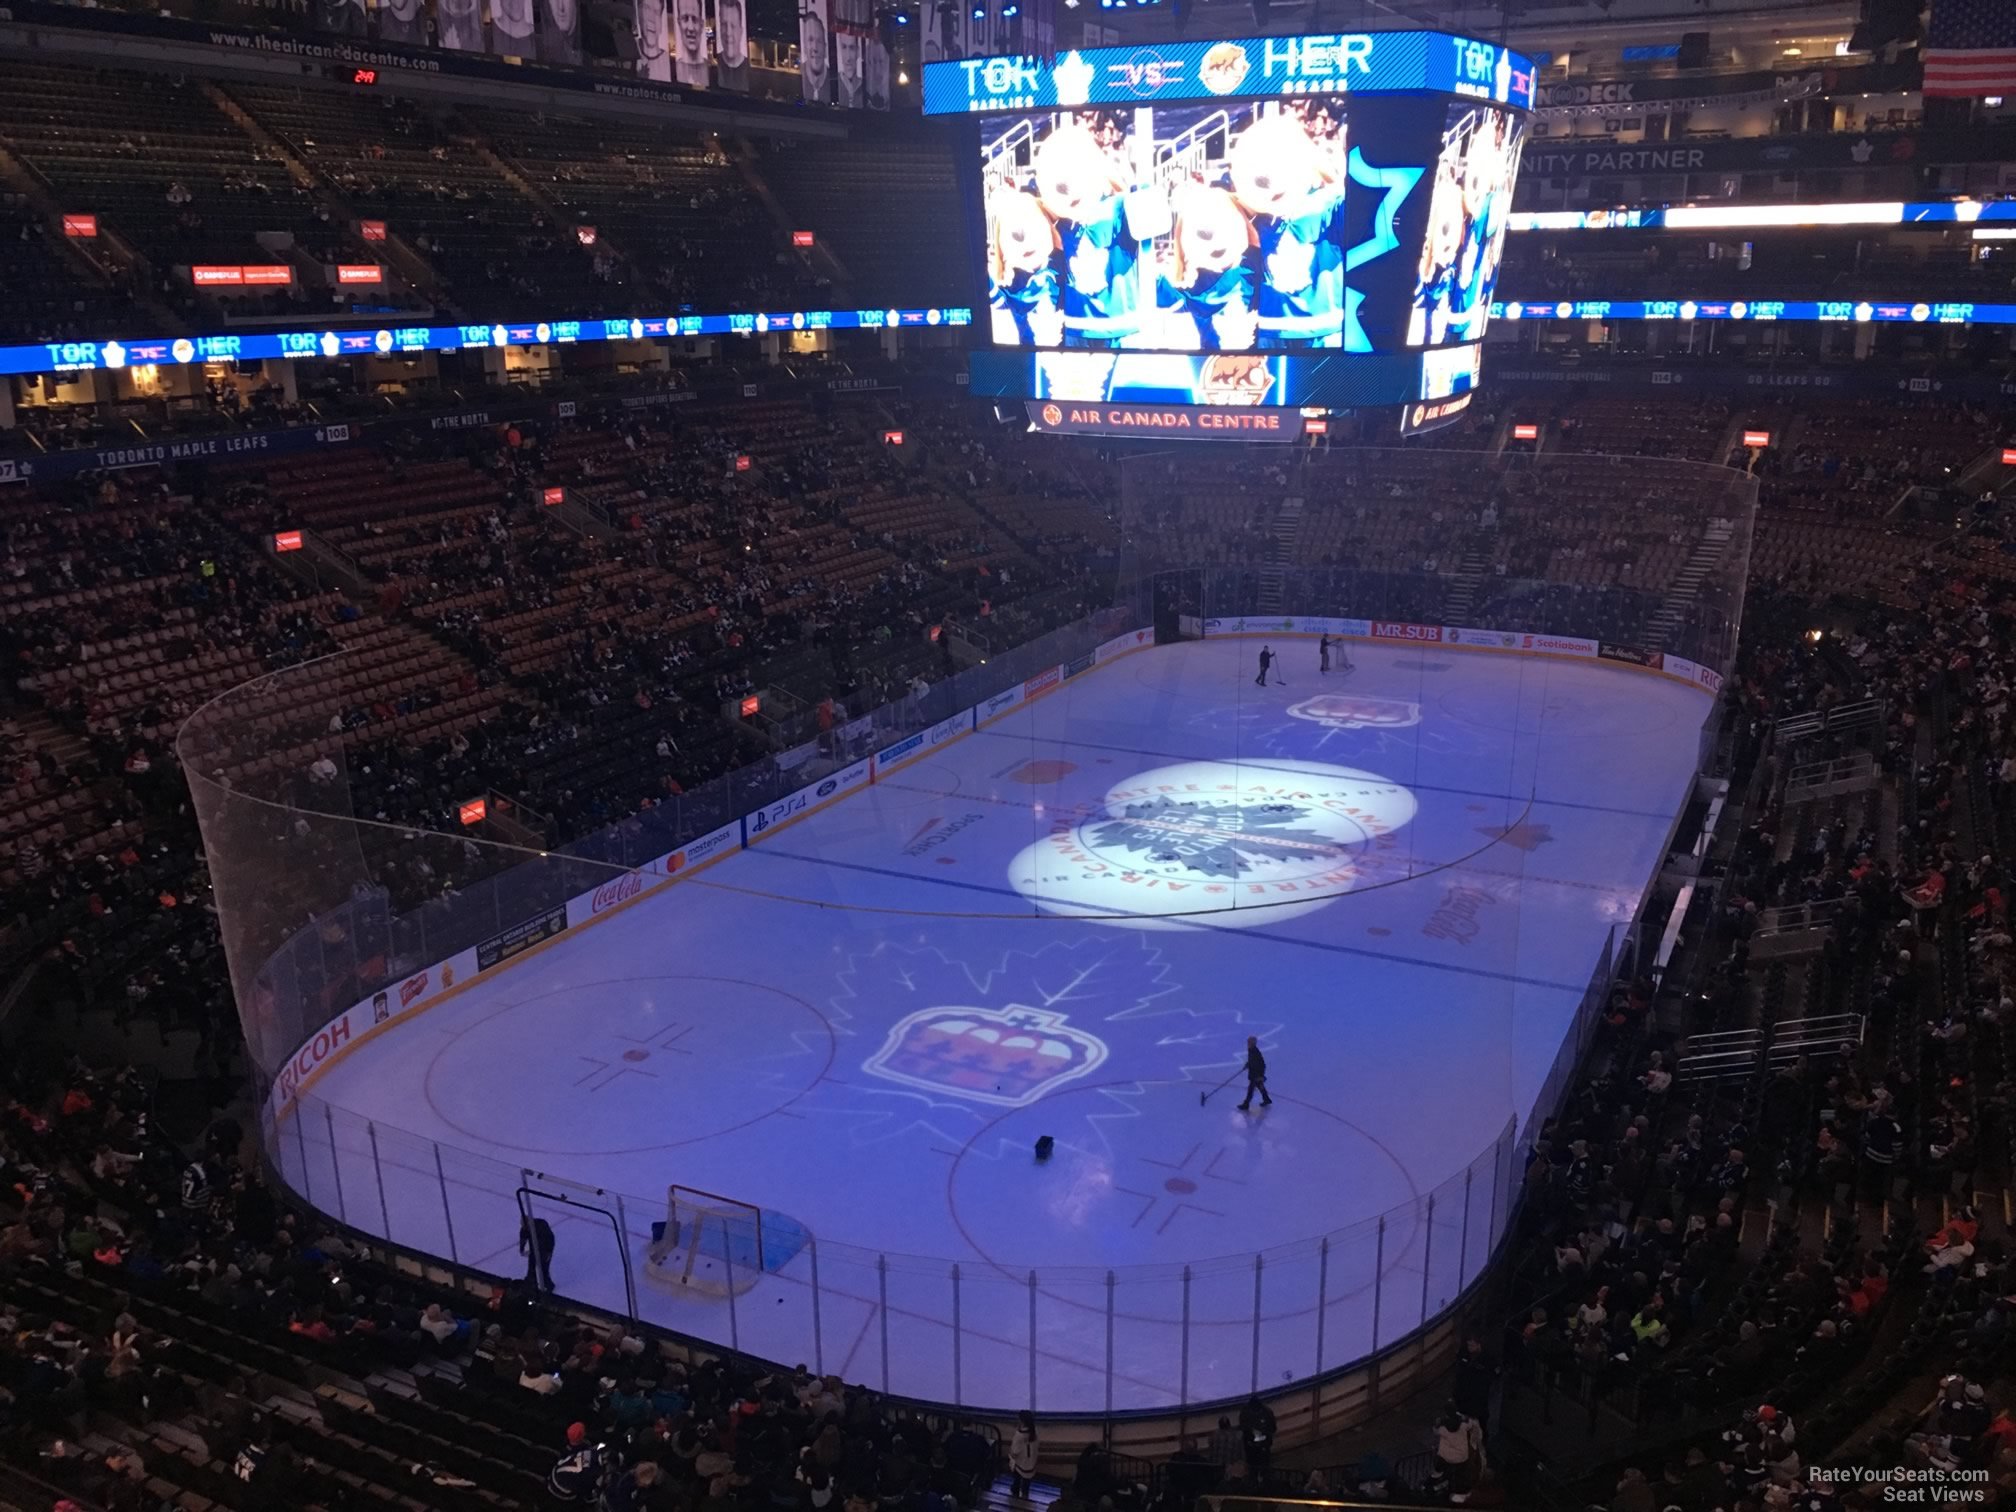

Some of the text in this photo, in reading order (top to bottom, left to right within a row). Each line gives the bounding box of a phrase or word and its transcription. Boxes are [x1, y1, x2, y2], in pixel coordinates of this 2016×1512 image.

[1263, 34, 1373, 77] HER
[594, 82, 682, 103] www.raptors.com
[1575, 82, 1634, 103] DECK
[1585, 149, 1705, 170] PARTNER
[857, 310, 884, 323] TOR
[1576, 301, 1611, 314] HER
[1643, 301, 1678, 314] TOR
[1750, 301, 1785, 315] HER
[1817, 302, 1853, 316] TOR
[1934, 303, 1975, 318] HER
[603, 319, 629, 333] TOR
[679, 316, 703, 330] HER
[728, 314, 754, 328] TOR
[806, 311, 832, 324] HER
[277, 333, 317, 351] TOR
[395, 328, 430, 346] HER
[458, 325, 490, 341] TOR
[552, 321, 580, 337] HER
[46, 343, 97, 363] TOR
[197, 336, 241, 355] HER
[1769, 375, 1808, 386] LEAFS
[1071, 410, 1281, 430] AIR CANADA CENTRE
[328, 427, 348, 439] 108
[97, 435, 268, 466] TORONTO MAPLE LEAFS
[1375, 623, 1438, 641] MR.SUB
[1536, 638, 1593, 652] Scotiabank
[772, 794, 807, 822] PS4
[687, 830, 730, 857] masterpass
[591, 871, 642, 915] Coca-Cola
[278, 1015, 351, 1101] RICOH
